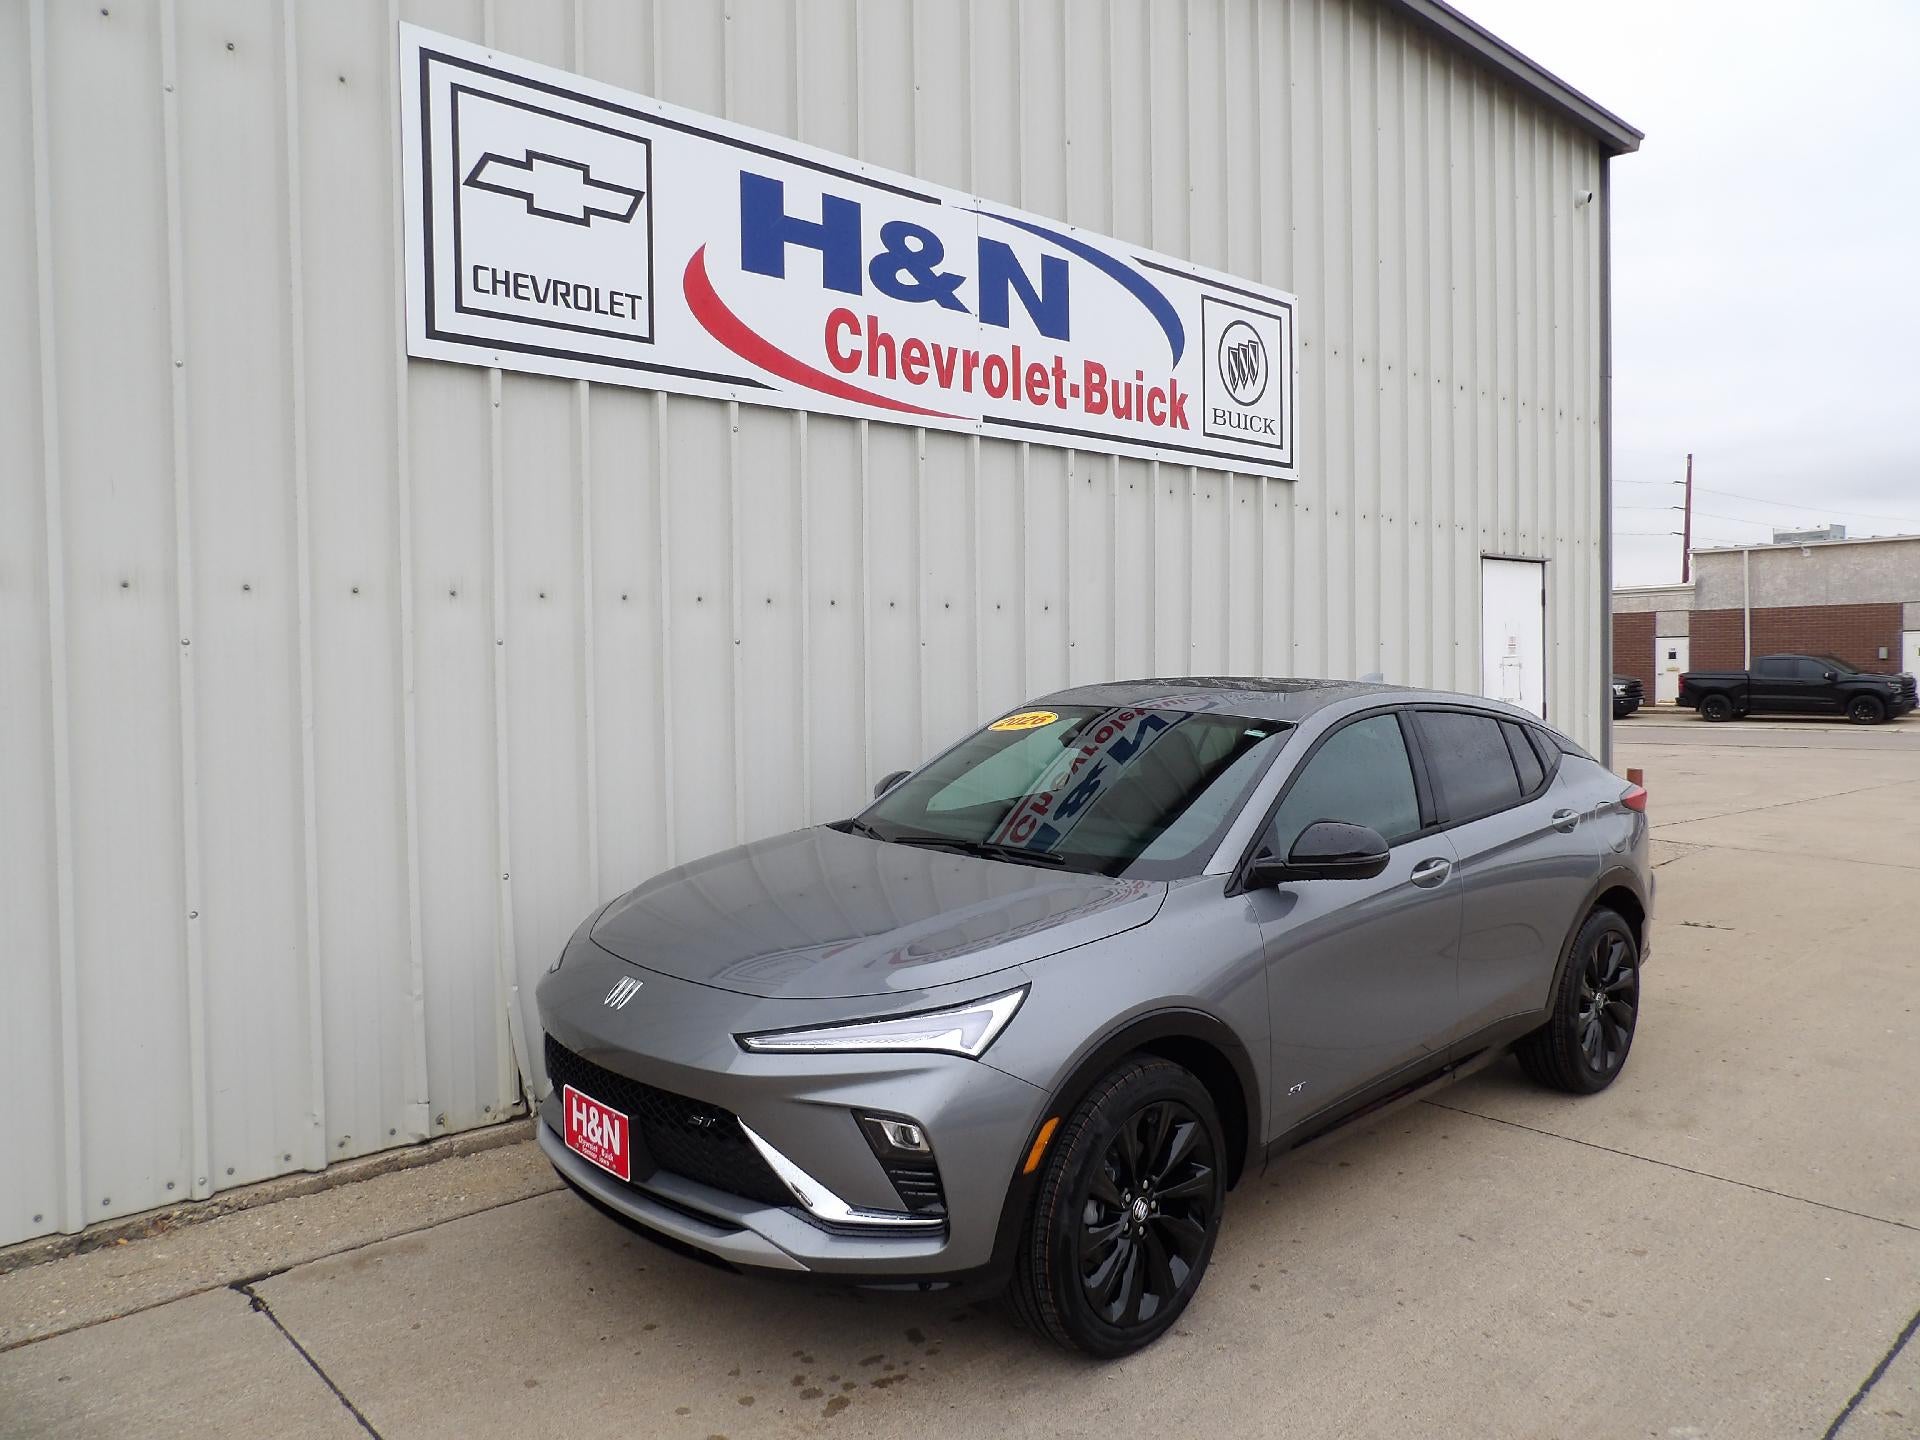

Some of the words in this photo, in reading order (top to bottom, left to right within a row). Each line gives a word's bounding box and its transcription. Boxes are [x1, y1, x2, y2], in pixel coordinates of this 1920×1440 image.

[739, 169, 1071, 342] H&N
[472, 264, 643, 320] CHEVROLET
[824, 307, 1190, 431] Chevrolet-Buick
[1212, 407, 1276, 436] BUICK
[572, 1096, 620, 1156] H&N
